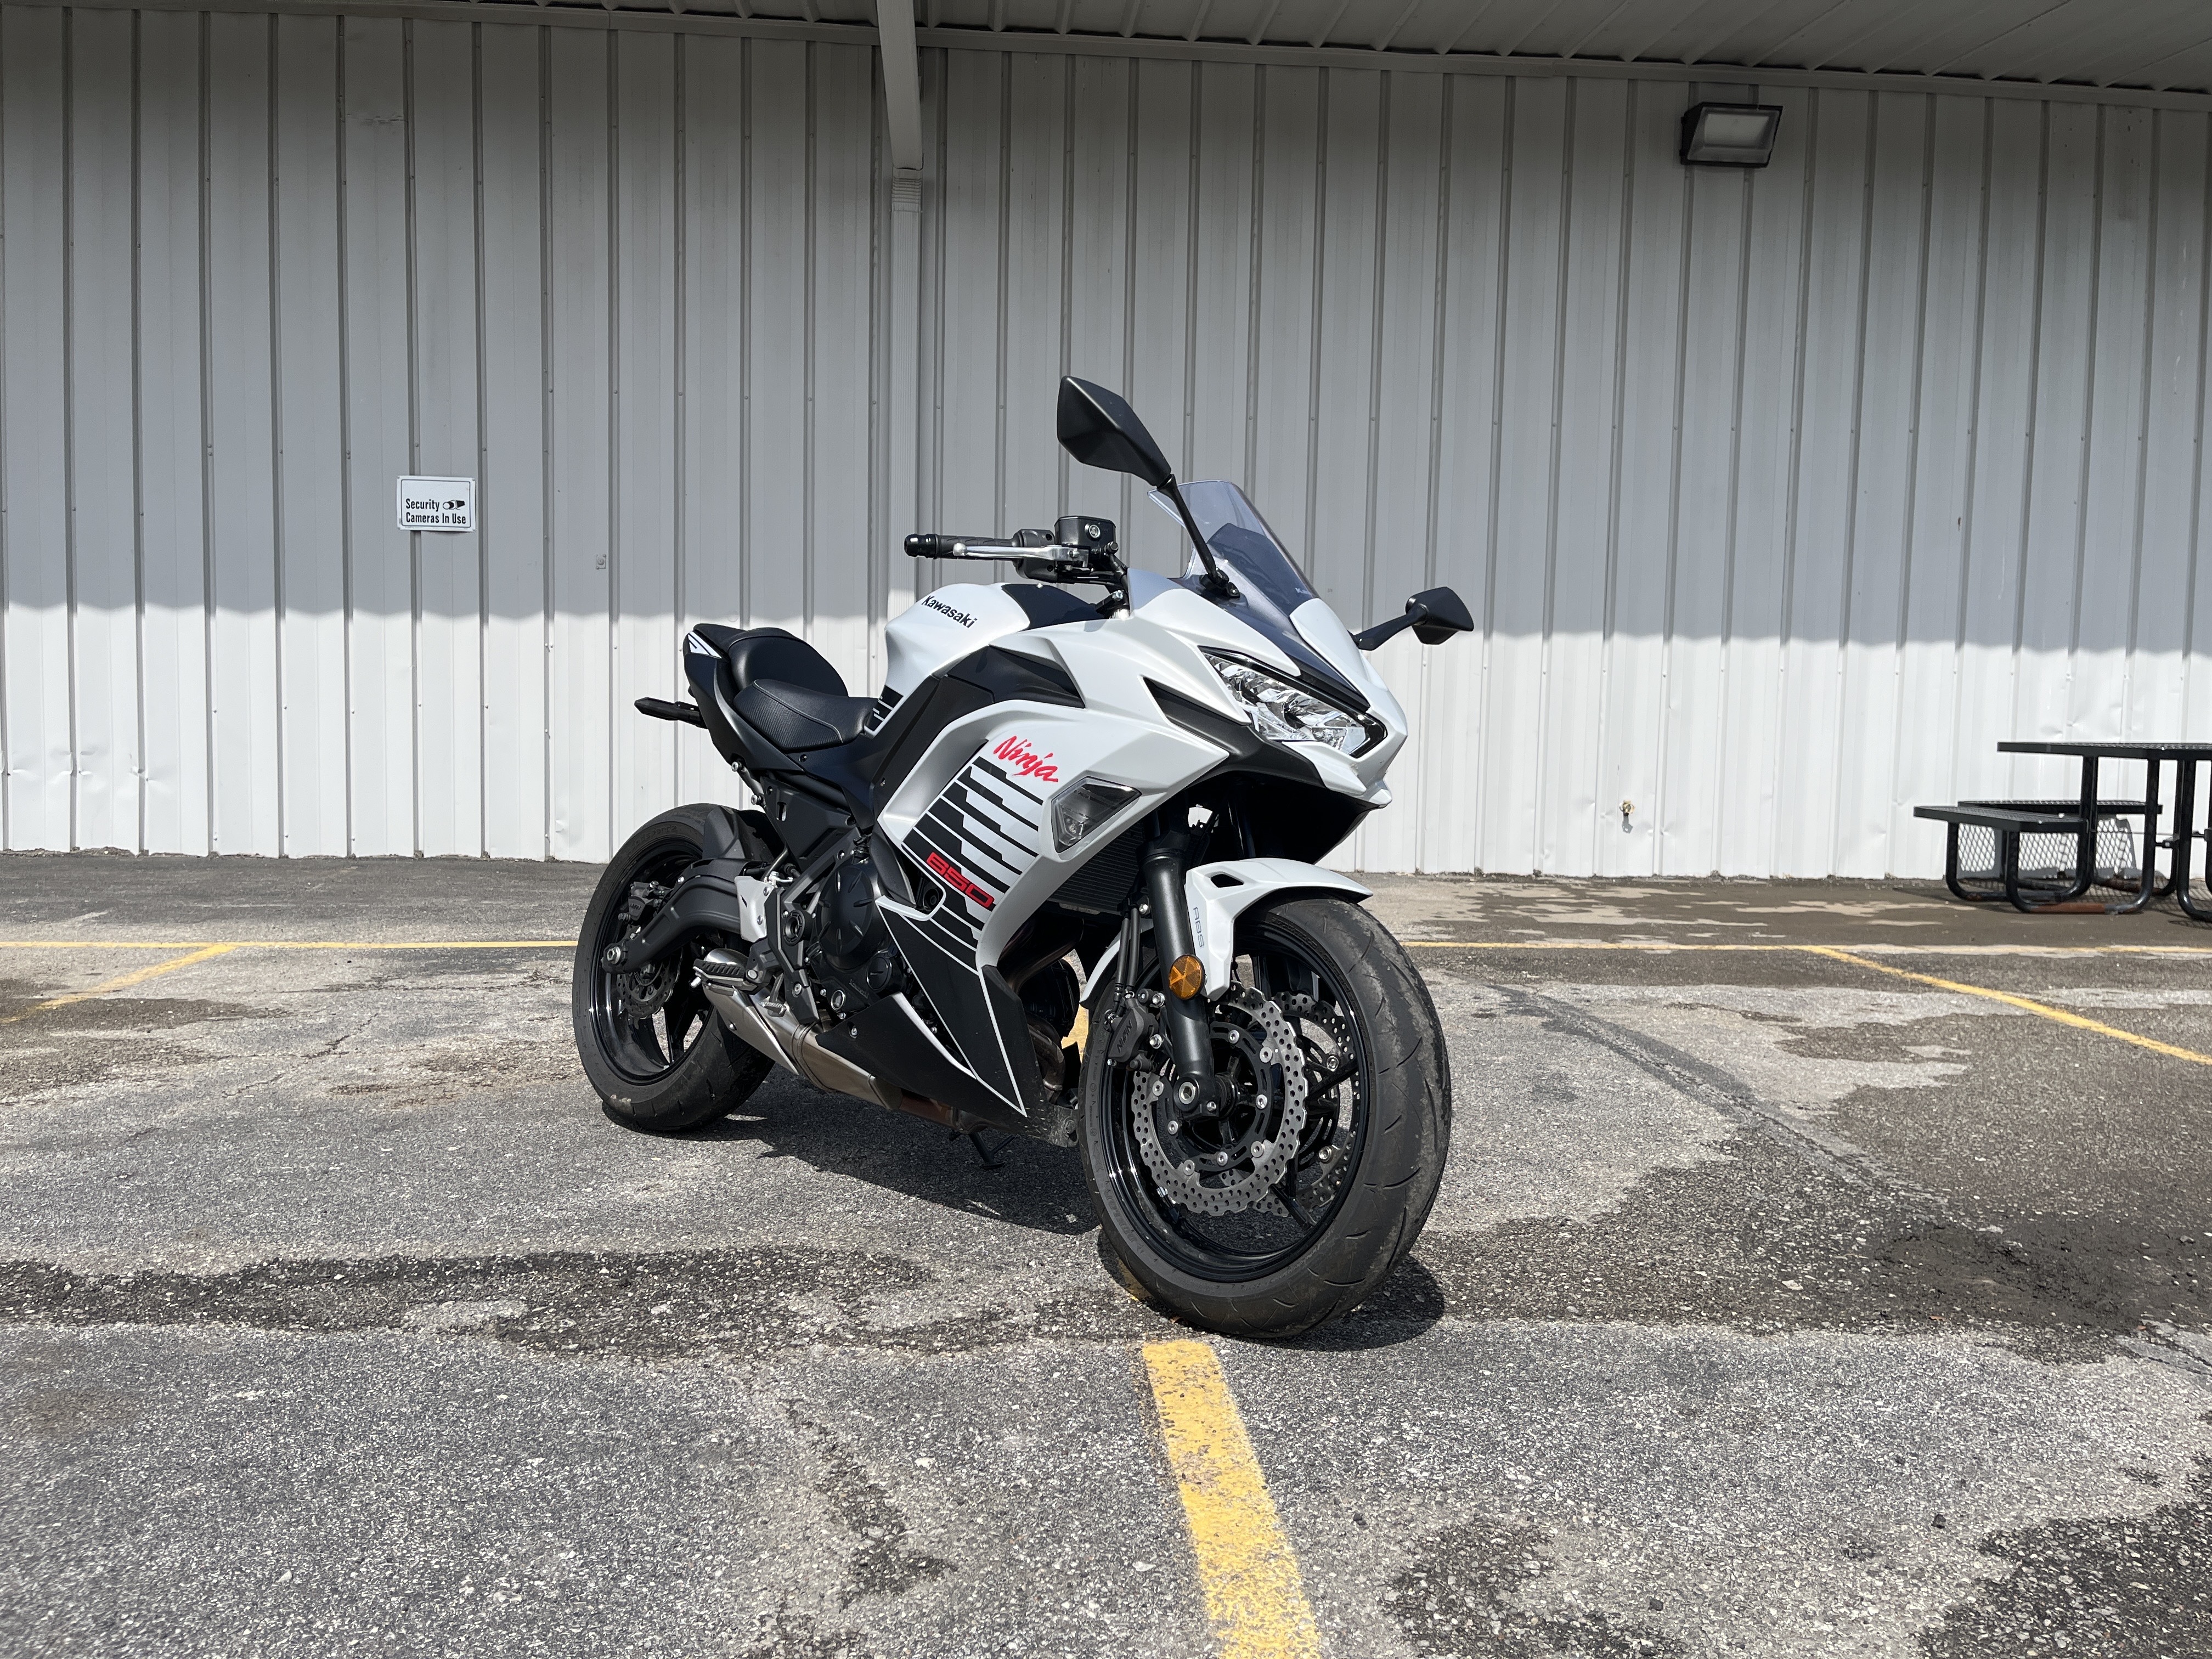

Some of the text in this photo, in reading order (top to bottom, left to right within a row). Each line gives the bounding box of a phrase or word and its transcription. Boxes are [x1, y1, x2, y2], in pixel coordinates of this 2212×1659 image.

[405, 498, 439, 512] Security
[406, 512, 466, 524] Cameras In Use
[921, 595, 978, 629] Kawasaki
[993, 735, 1058, 782] Ninja
[926, 851, 995, 909] 650
[1193, 907, 1204, 947] ABS
